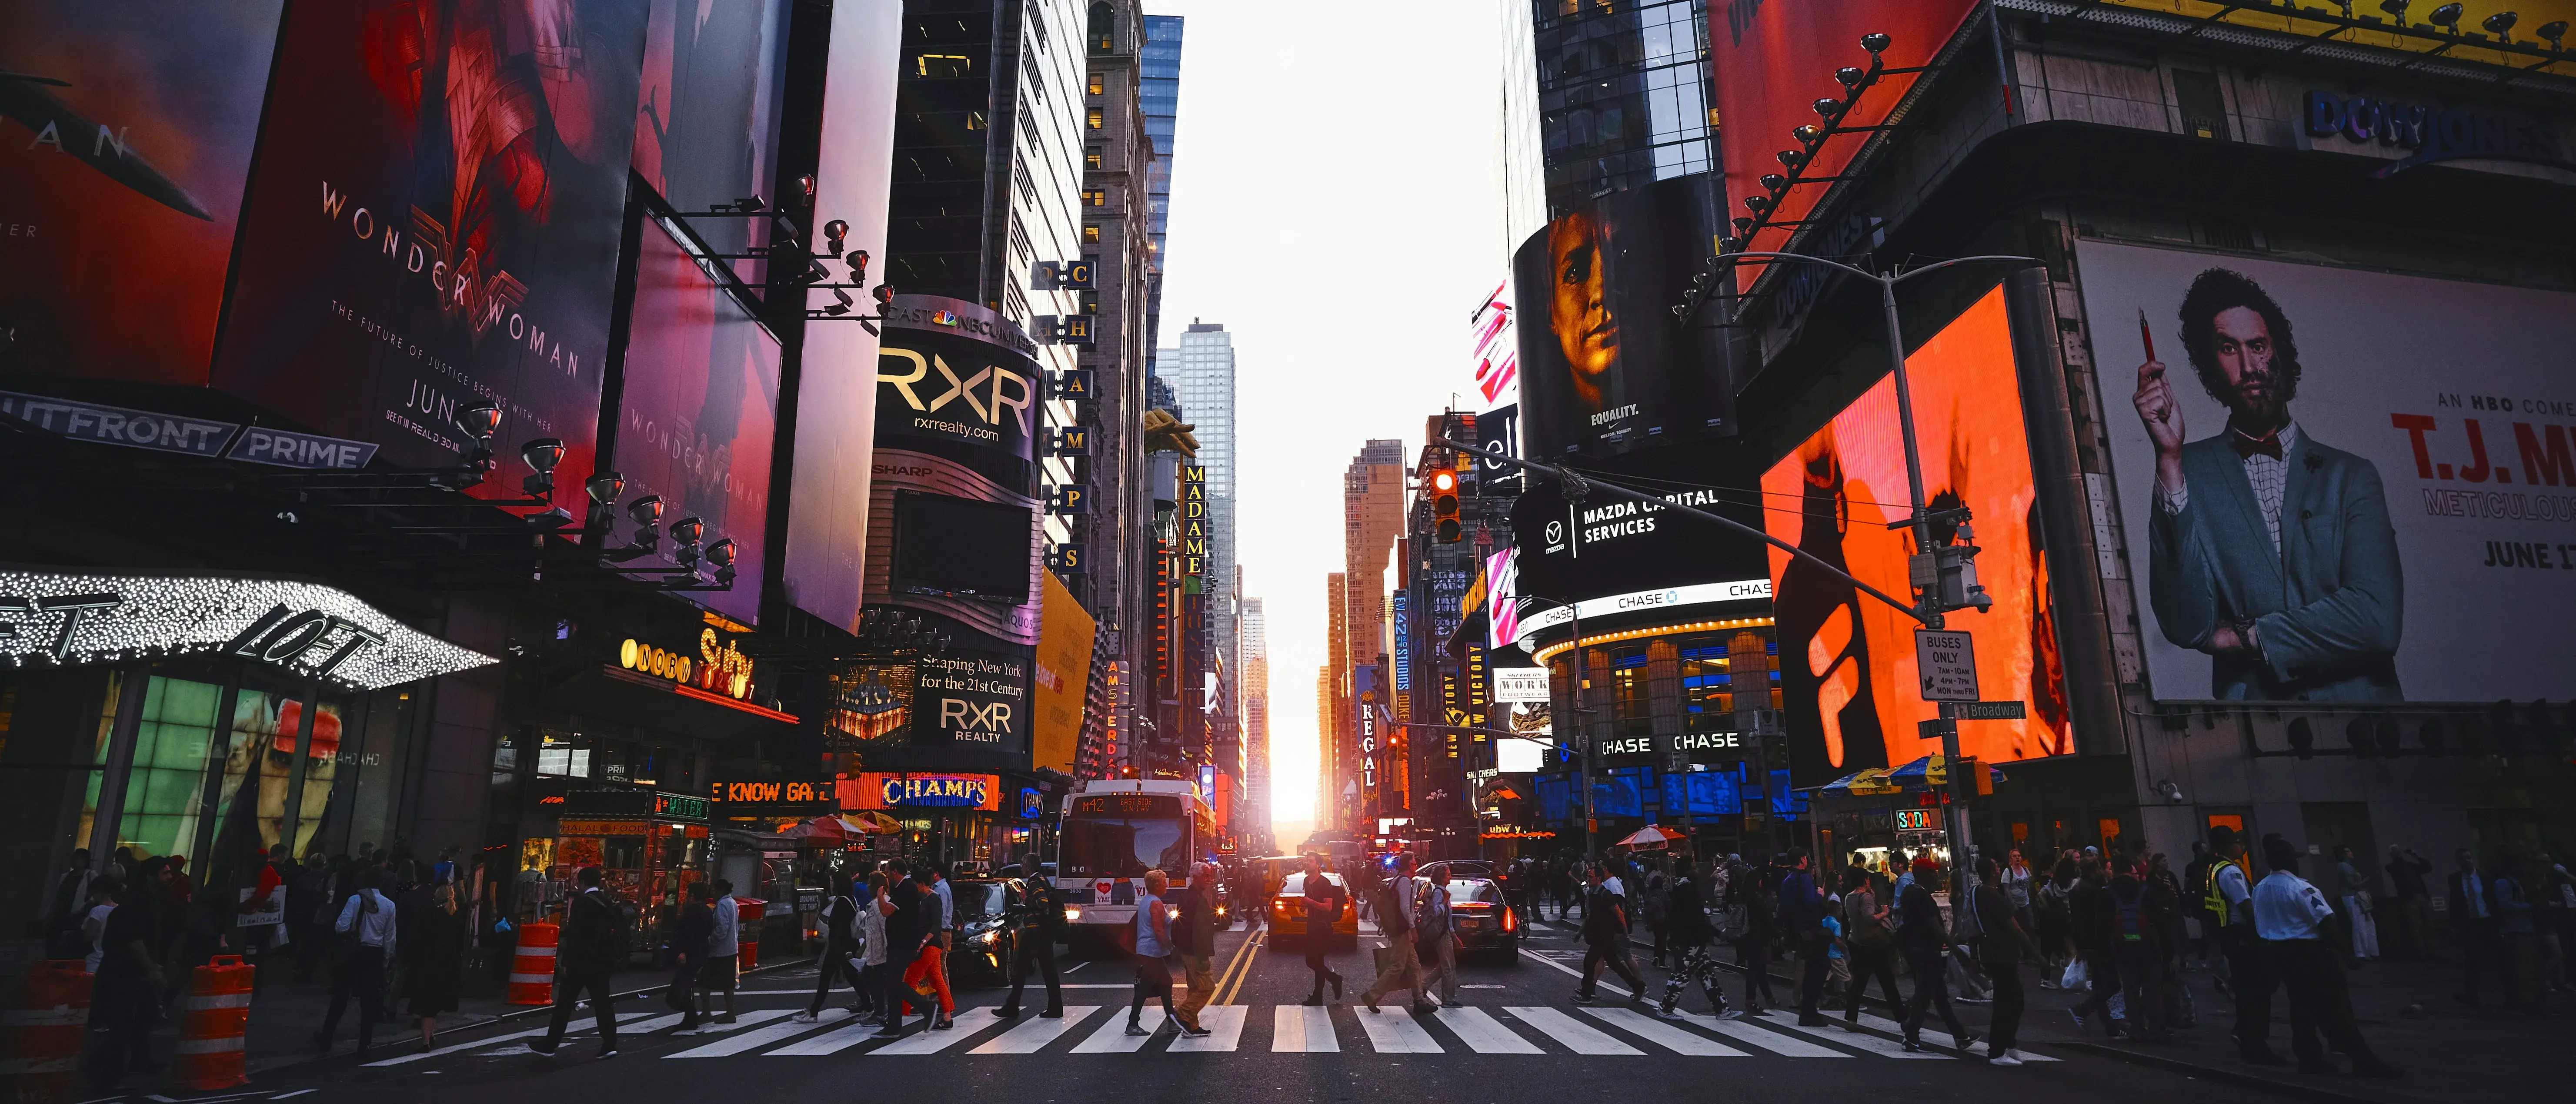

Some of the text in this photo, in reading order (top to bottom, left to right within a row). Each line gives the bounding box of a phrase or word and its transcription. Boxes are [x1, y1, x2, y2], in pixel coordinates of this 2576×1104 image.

[2303, 90, 2425, 149] DOW
[0, 115, 130, 159] AN
[0, 223, 36, 238] ER
[323, 180, 579, 378] WONDER WOMAN
[331, 300, 551, 432] THE FUTURE OF JUSTICE BEGINS WITH HER
[407, 378, 463, 425] JUN
[877, 347, 1029, 438] RXR
[2439, 392, 2463, 408] AN
[2470, 395, 2514, 412] HBO
[1591, 404, 1639, 426] EQUALITY.
[386, 409, 397, 423] SEE
[397, 414, 403, 425] IT
[404, 417, 410, 429] IN
[440, 436, 451, 449] 3D
[452, 442, 460, 454] AN
[914, 416, 999, 442] rxrrealty.com
[248, 433, 361, 468] PRIME
[631, 408, 762, 511] WONDER WOMAN
[2390, 413, 2513, 483] T.J.
[872, 465, 933, 477] SHARP
[634, 479, 646, 492] THE
[673, 502, 681, 512] OF
[707, 521, 725, 536] BEGINS
[741, 541, 750, 550] HER
[1186, 466, 1204, 573] MADAME
[1583, 500, 1637, 525] MAZDA
[1585, 517, 1655, 543] SERVICES
[1546, 544, 1565, 555] mazda
[2484, 541, 2553, 569] JUNE
[1546, 609, 1572, 623] CHASE
[1618, 593, 1663, 609] CHASE
[1003, 613, 1034, 630] AQUOS
[233, 603, 385, 676] LOFT
[1927, 636, 1961, 649] BUSES
[642, 649, 690, 680] N Q R W
[922, 654, 1021, 678] Shaping New York
[1396, 649, 1409, 690] STUDIOS
[1932, 652, 1958, 663] ONLY
[727, 673, 735, 692] 3
[749, 684, 755, 699] 7
[921, 674, 1024, 700] for the 21st Century
[1470, 646, 1485, 742] NEW VICTORY
[1502, 680, 1548, 689] WORK
[940, 697, 1012, 733] RXR
[1398, 695, 1410, 719] DUKE
[1971, 703, 2022, 718] Broadway
[956, 731, 1001, 743] REALTY
[1362, 704, 1376, 786] REGAL
[1447, 734, 1458, 758] NEW
[1602, 732, 1739, 755] CHASE CHASE
[1466, 768, 1497, 780] SKCHERS
[728, 783, 781, 802] KNOW
[883, 779, 986, 804] CHAMPS
[1025, 792, 1043, 815] CHAMPS
[669, 797, 703, 816] WATER
[1082, 798, 1104, 812] M42
[613, 824, 644, 833] FOOD
[1899, 811, 1931, 828] SODA
